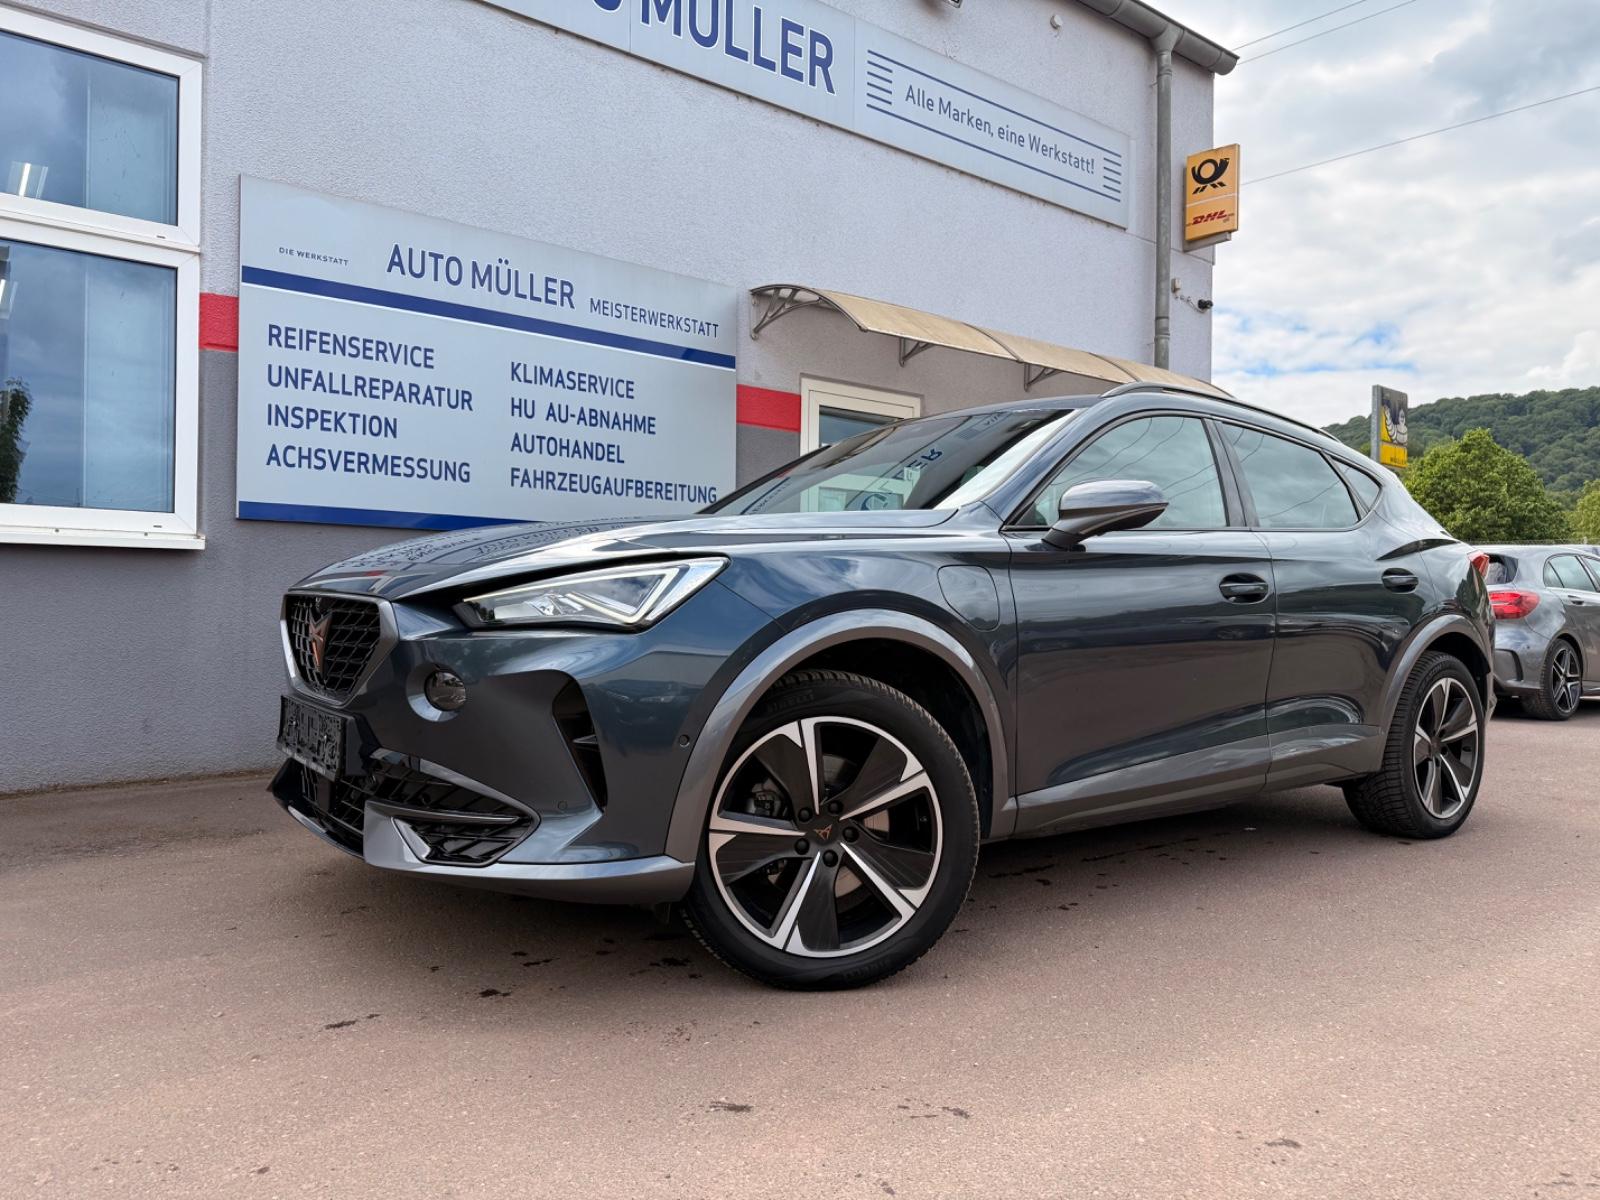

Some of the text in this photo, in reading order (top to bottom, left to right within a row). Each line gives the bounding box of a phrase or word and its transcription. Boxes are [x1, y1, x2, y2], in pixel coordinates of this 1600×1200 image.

[905, 84, 1095, 175] Alle Marken, eine Werkstatt!
[1192, 209, 1228, 226] DHL
[279, 246, 349, 266] DIE WERKSTATT
[386, 243, 575, 309] AUTO MÜLLER
[590, 297, 720, 339] MEISTERWERKSTATT
[268, 323, 435, 370] REIFENSERVICE
[267, 363, 473, 412] UNFALLREPARATUR
[511, 361, 635, 400] KLIMASERVICE
[267, 403, 398, 439] INSPEKTION
[511, 397, 656, 435] HU AU-ABNAHME
[265, 443, 471, 484] ACHSVERMESSUNG
[510, 432, 625, 464] AUTOHANDEL
[510, 467, 718, 504] FAHRZEUGAUFBEREITUNG
